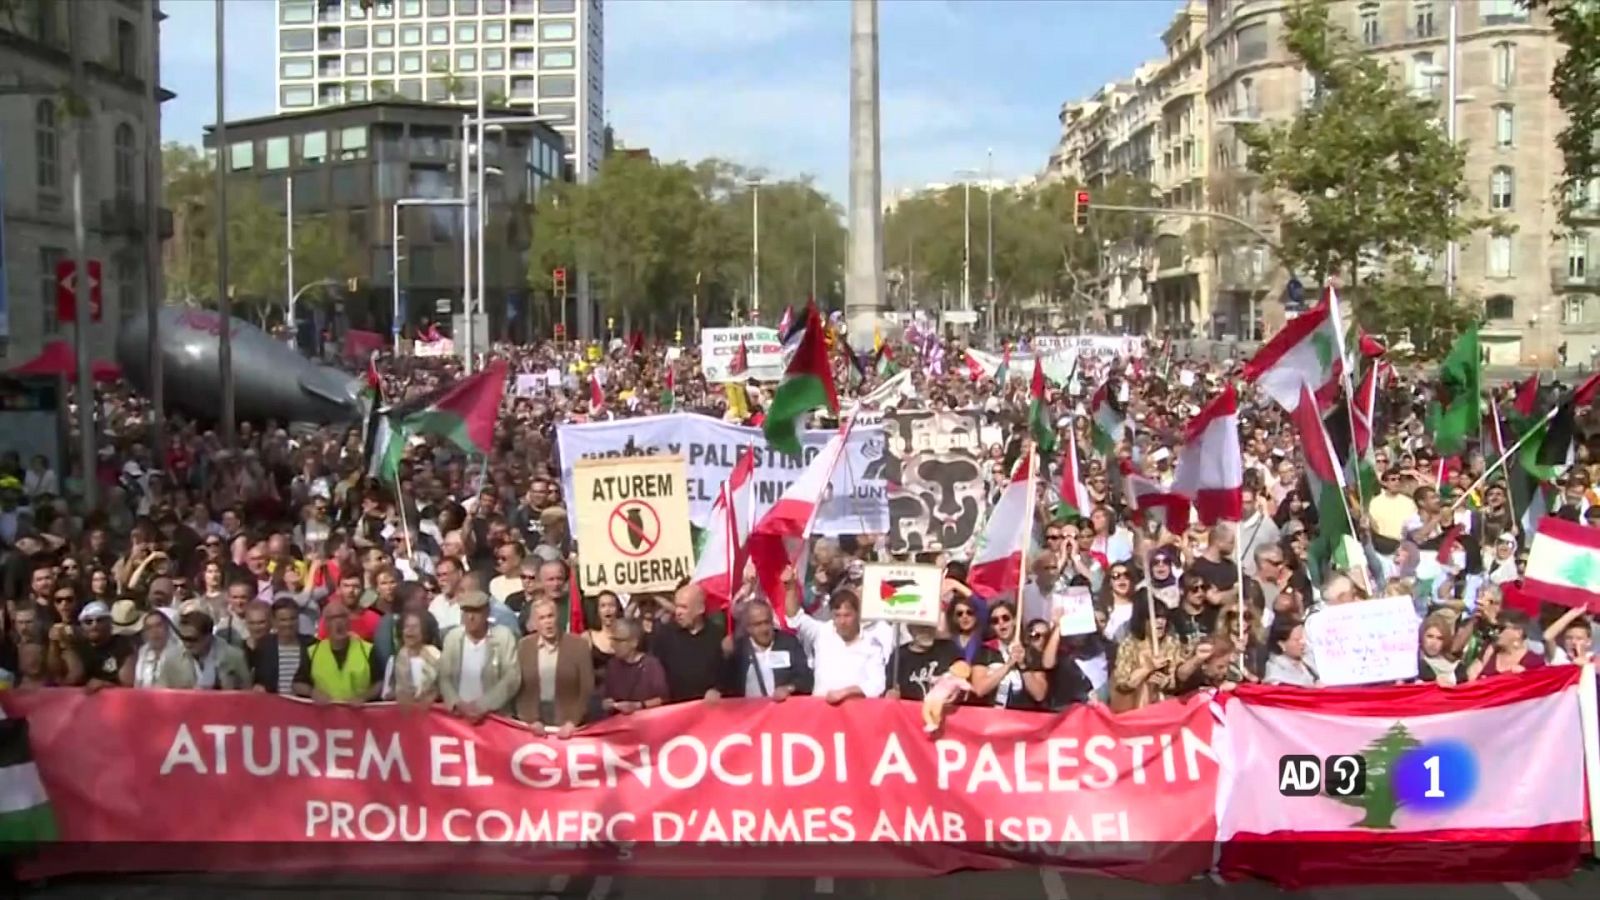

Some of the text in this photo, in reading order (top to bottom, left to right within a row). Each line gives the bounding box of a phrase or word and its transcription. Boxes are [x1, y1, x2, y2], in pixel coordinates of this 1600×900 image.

[592, 473, 673, 501] ATUREM
[586, 556, 690, 587] LA GUERRA!
[160, 723, 1219, 794] ATUREM EL GENOCIDI A PALESTIN
[305, 800, 1136, 860] PROU COMERÇ D'ARMES AMB ISRAEL
